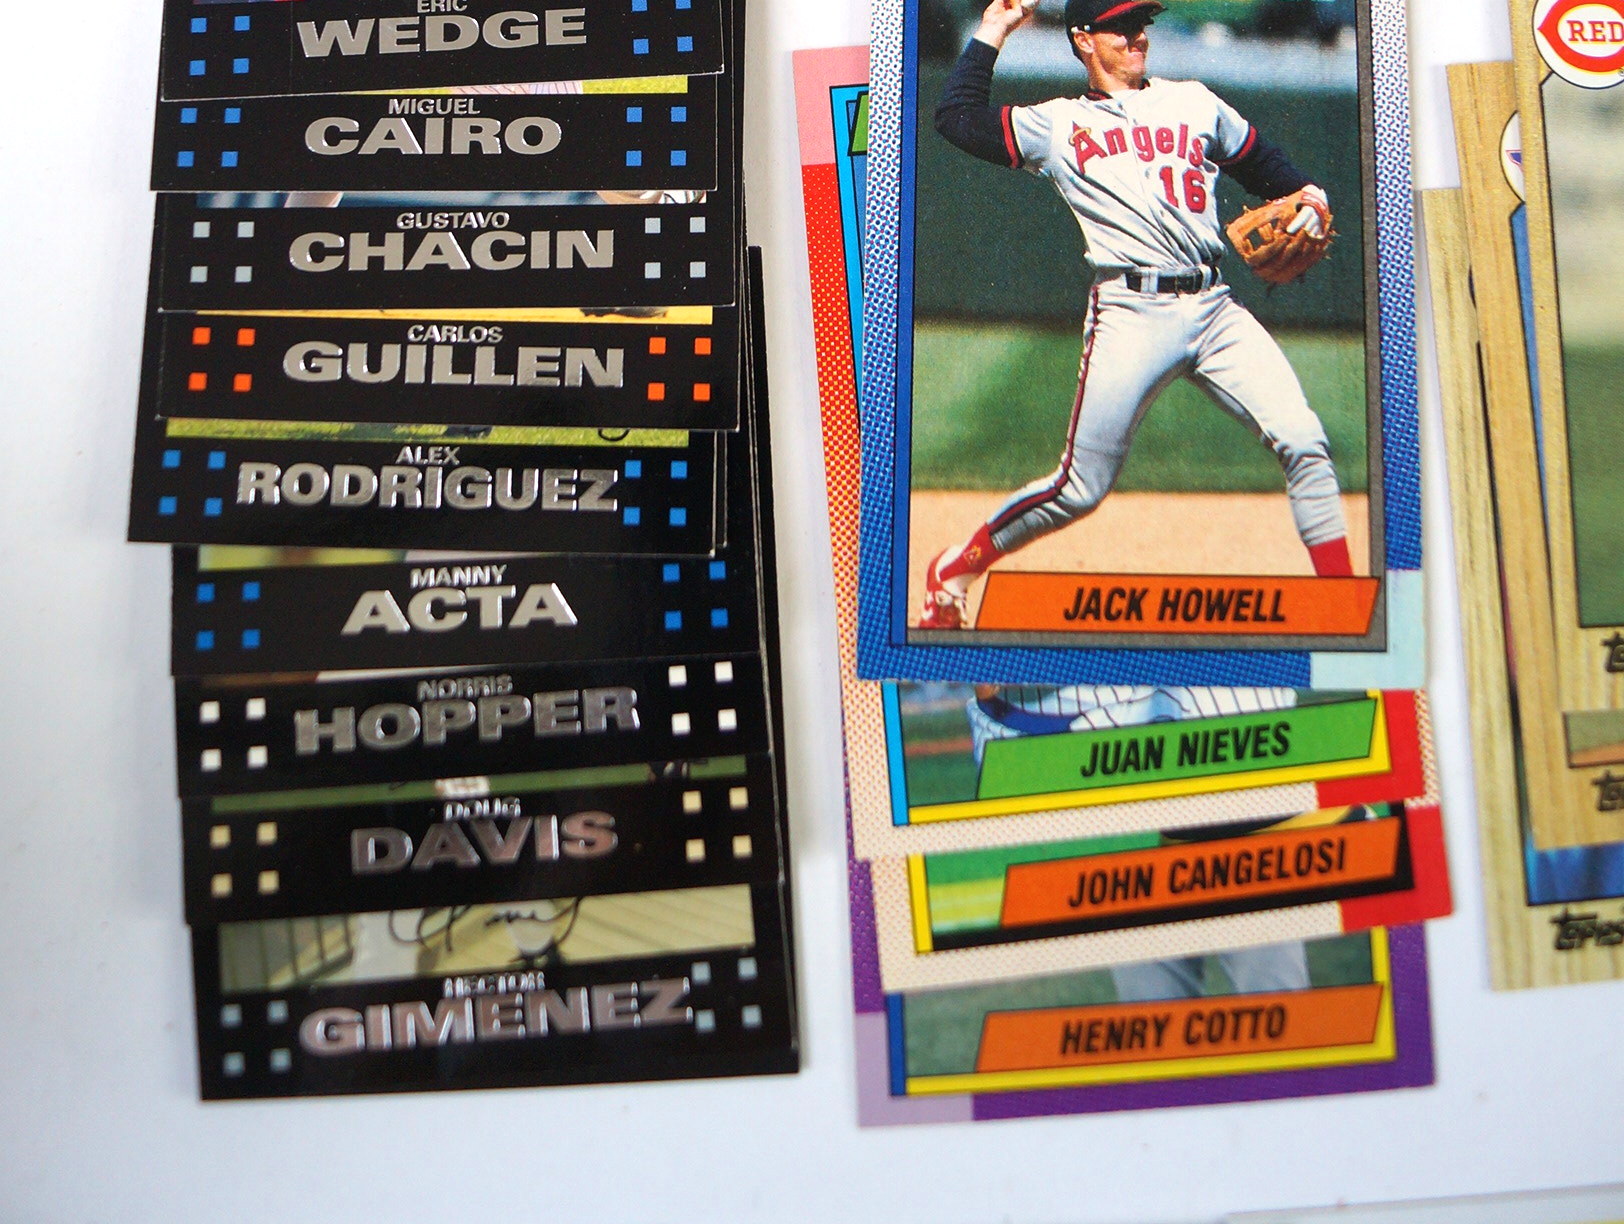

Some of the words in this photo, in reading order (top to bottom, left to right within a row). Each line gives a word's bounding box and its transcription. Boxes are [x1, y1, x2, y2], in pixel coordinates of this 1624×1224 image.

[296, 7, 587, 59] WEDGE
[388, 97, 480, 117] MIGUEL
[304, 116, 562, 157] CAIRO
[1070, 120, 1205, 175] Angels
[1158, 165, 1208, 214] 16
[396, 211, 510, 231] GUSTAVO
[288, 228, 615, 273] CHACIN
[407, 324, 504, 344] CARLOS
[282, 341, 624, 388] GUILLEN
[395, 445, 461, 466] ALEX
[235, 461, 619, 513] RODRIGUEZ
[410, 563, 508, 588] MANNY
[340, 582, 579, 636] ACTA
[1064, 588, 1148, 621] JACK
[1157, 590, 1287, 623] HOWELL
[416, 675, 514, 701] NORRIS
[294, 685, 640, 756] HOPPER
[1080, 738, 1163, 779] JUAN
[1176, 721, 1291, 767] NIEVES
[350, 810, 619, 874] DAVIS
[1067, 864, 1153, 910] JOHN
[1168, 838, 1346, 895] CANGELOSI
[300, 976, 694, 1058] GIMENEZ
[1060, 1015, 1172, 1057] HENRY
[1182, 1006, 1288, 1046] COTTO
